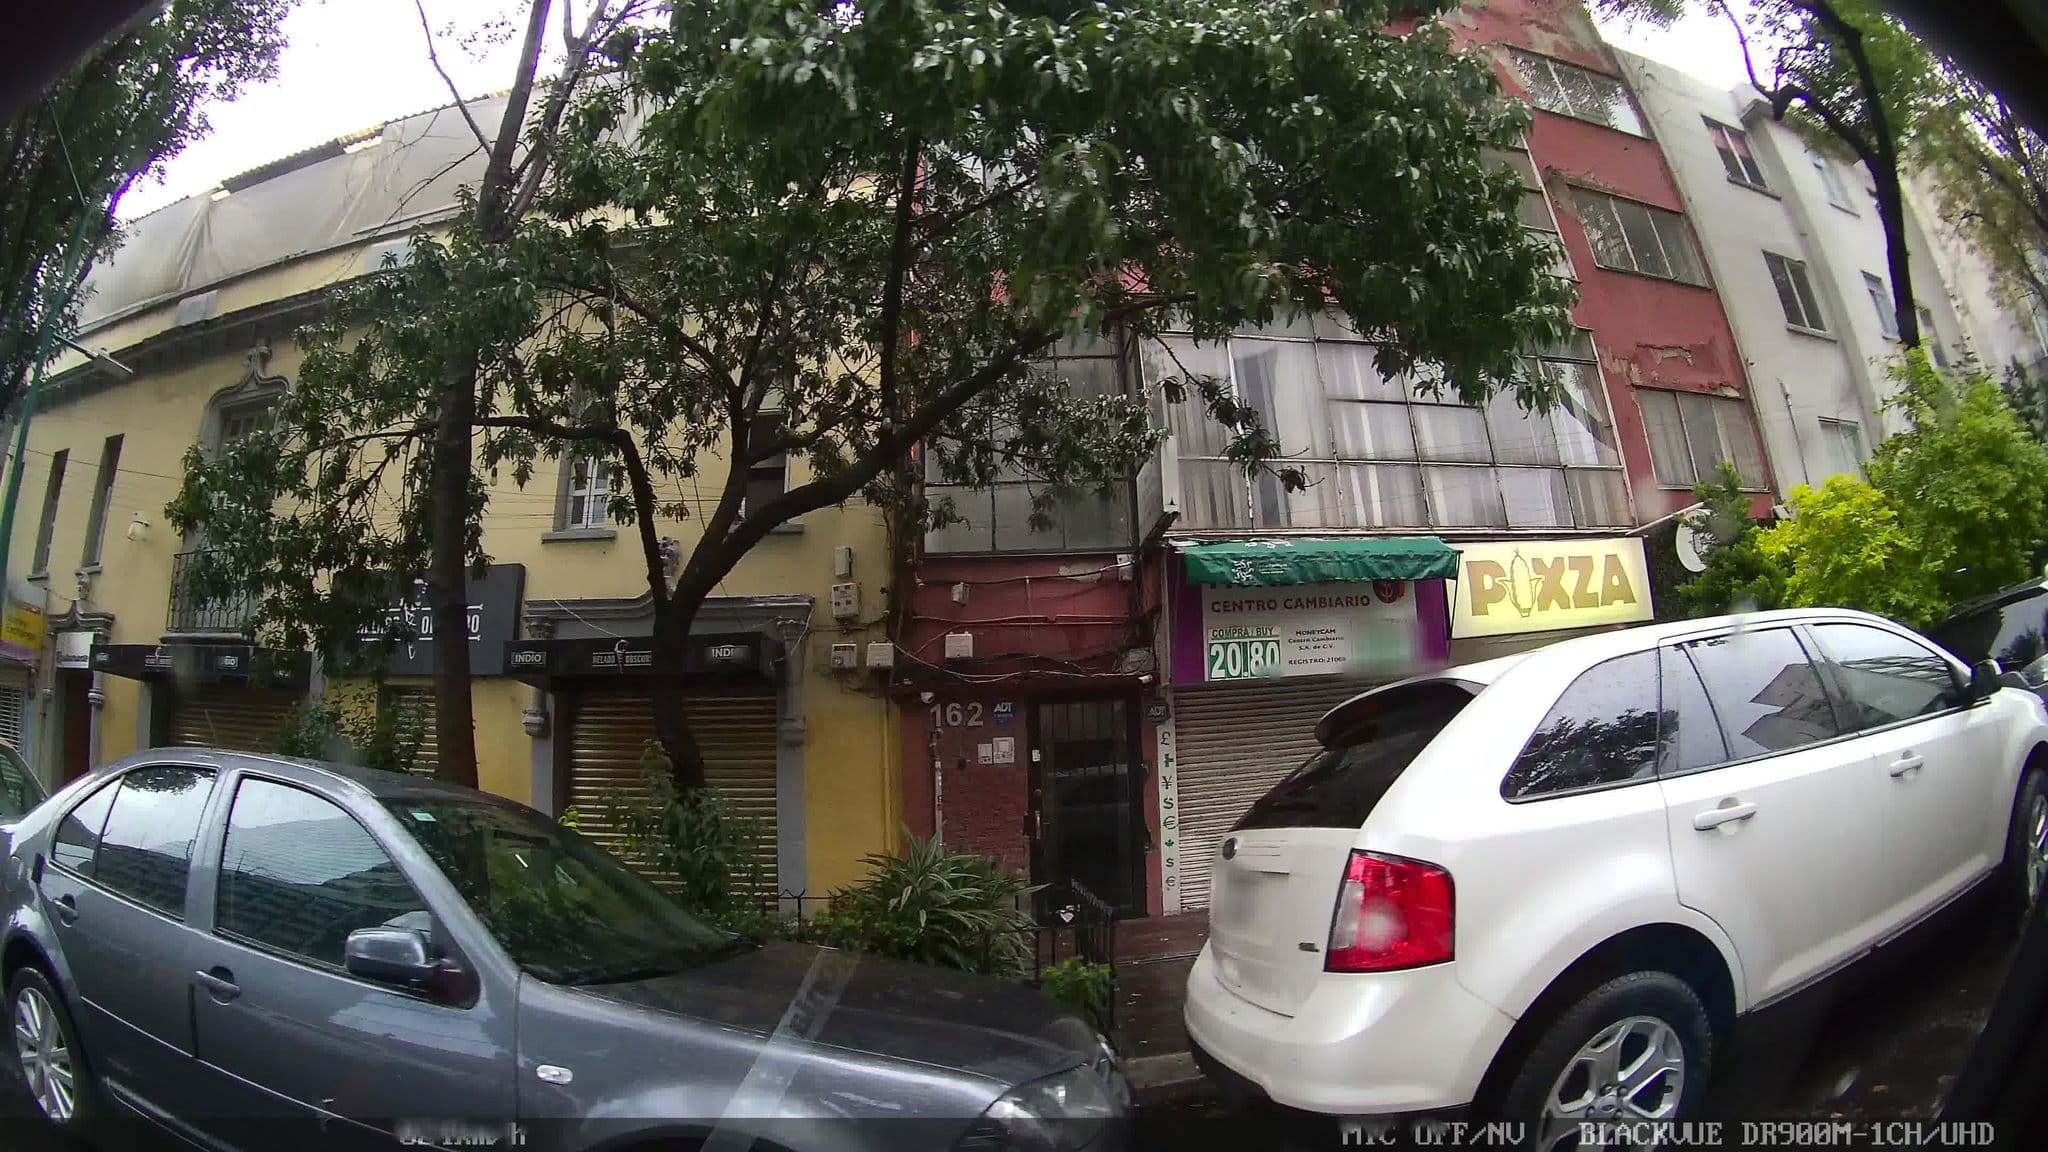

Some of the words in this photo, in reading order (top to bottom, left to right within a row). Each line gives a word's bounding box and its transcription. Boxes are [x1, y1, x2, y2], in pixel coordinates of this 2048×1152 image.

[1211, 599, 1277, 613] CENTRO
[1283, 595, 1370, 611] CAMBIARIO
[515, 654, 542, 663] INDIO
[1210, 641, 1279, 678] 20.80
[929, 702, 984, 727] 162
[993, 702, 1012, 713] ADT
[1149, 704, 1167, 716] ADT
